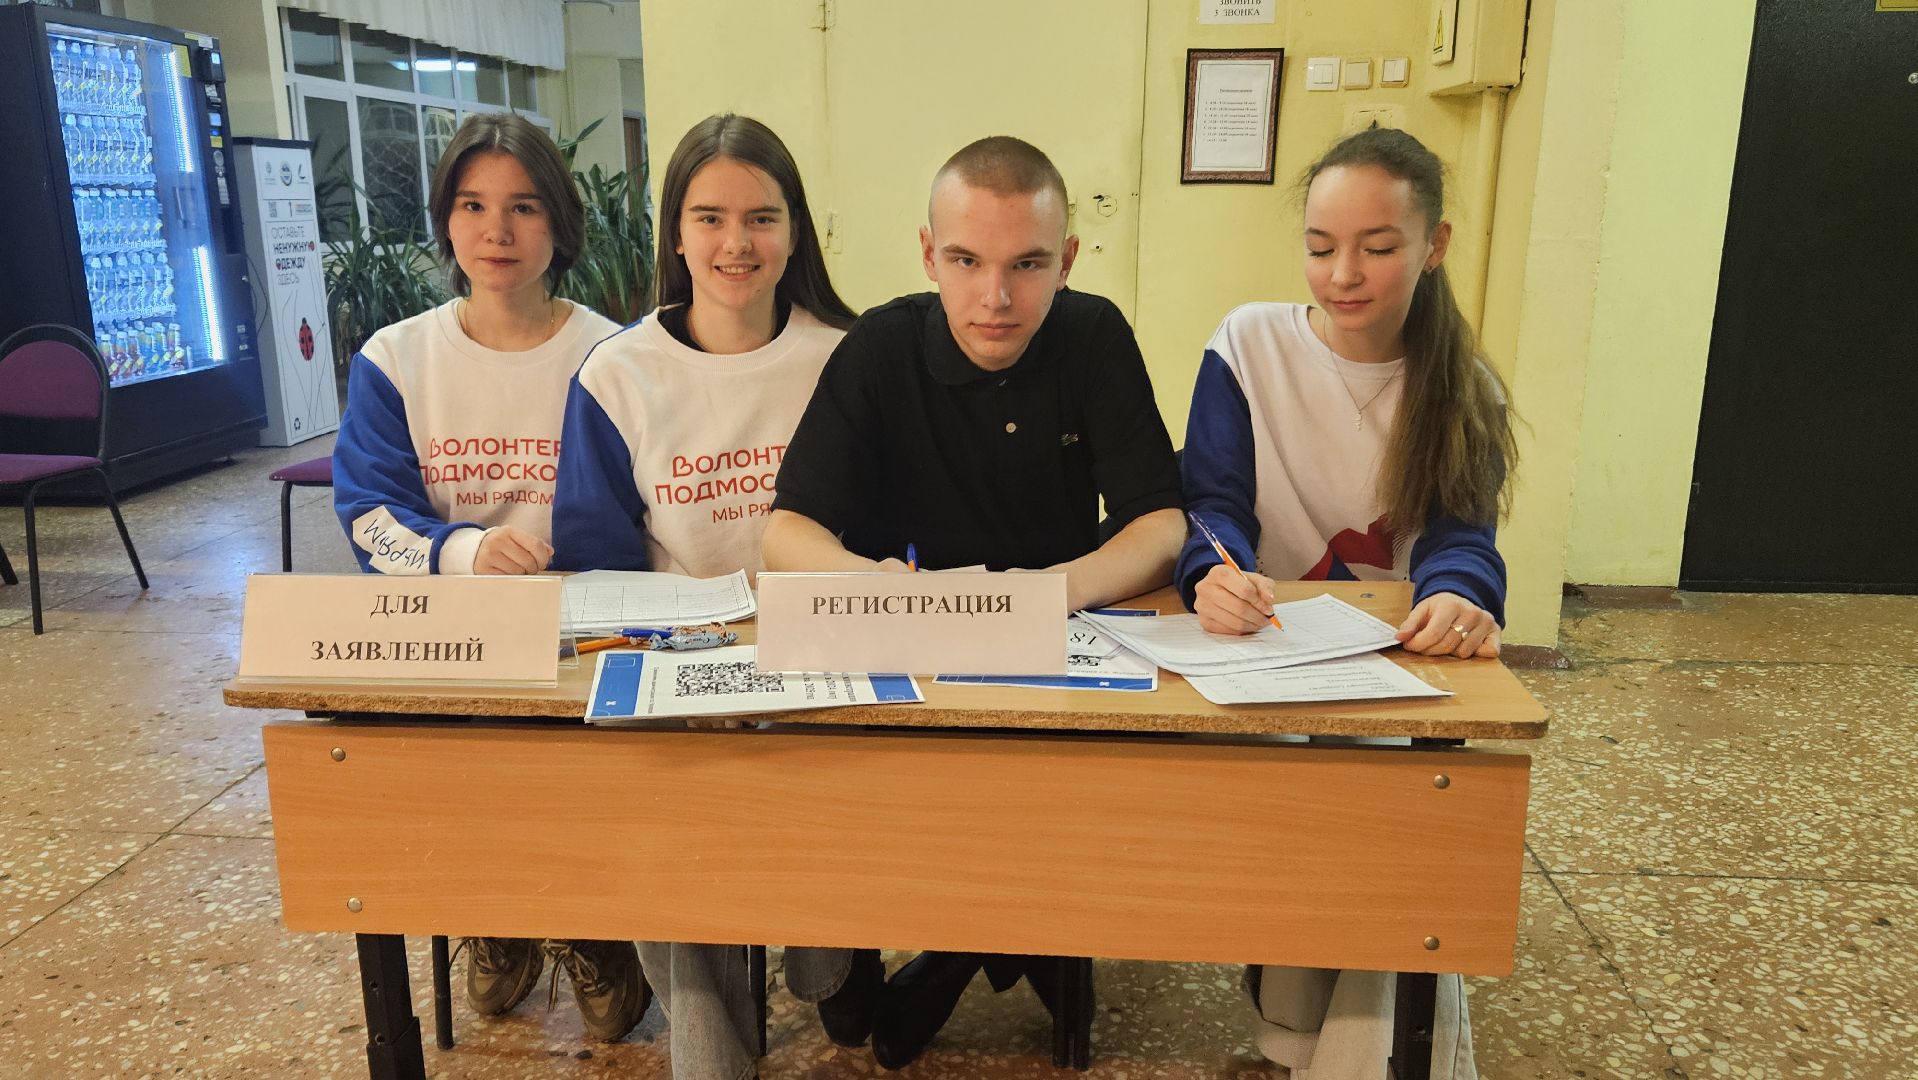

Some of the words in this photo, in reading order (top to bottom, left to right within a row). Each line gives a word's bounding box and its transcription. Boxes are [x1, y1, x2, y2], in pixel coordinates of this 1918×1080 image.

[1223, 8, 1260, 17] ЗВОНКА
[456, 491, 488, 506] МЫ
[493, 490, 554, 505] РЯДОМ
[712, 505, 744, 523] МЫ
[369, 594, 431, 619] ДЛЯ
[811, 594, 1014, 619] РЕГИСТРАЦИЯ
[310, 636, 485, 662] ЗАЯВЛЕНИЙ
